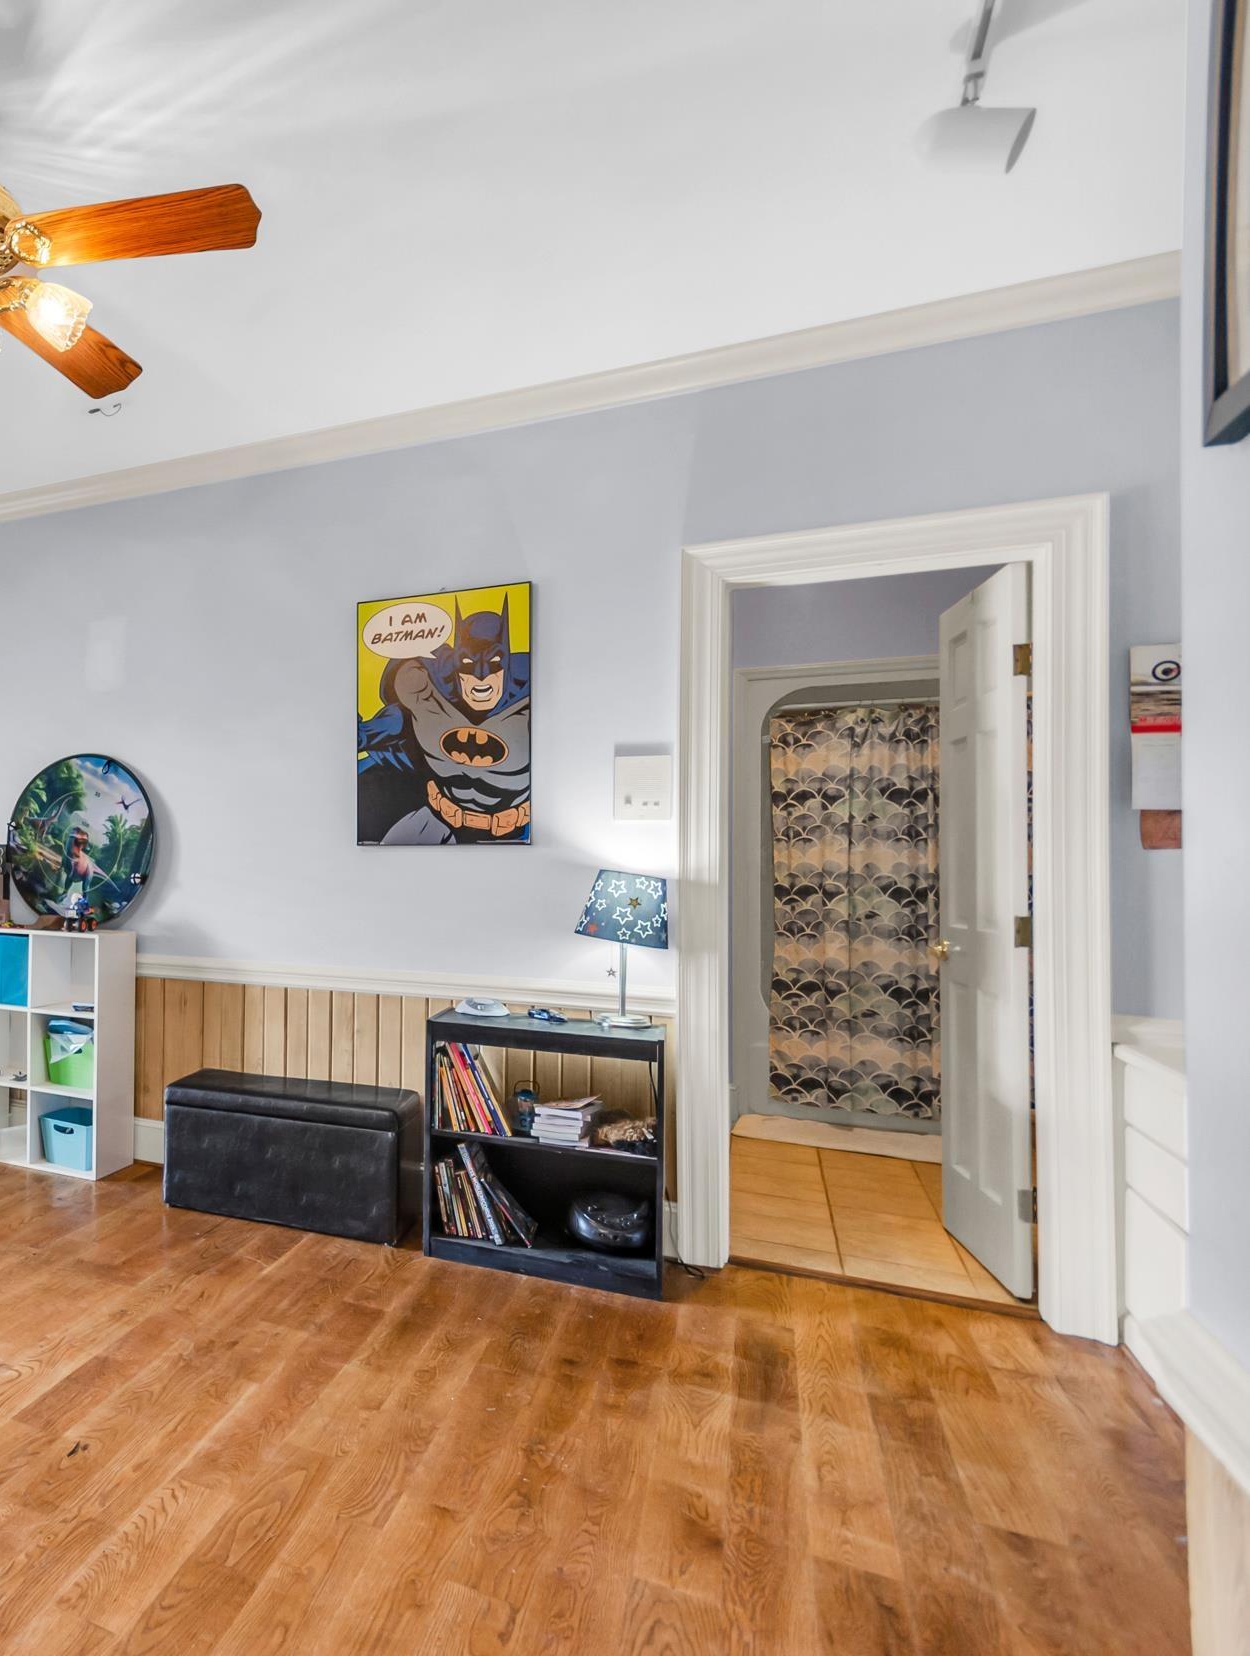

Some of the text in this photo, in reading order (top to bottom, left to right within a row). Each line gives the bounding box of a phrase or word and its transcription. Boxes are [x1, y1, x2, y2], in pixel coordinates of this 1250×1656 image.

[389, 612, 427, 627] I AM
[371, 625, 445, 645] BATMAN!
